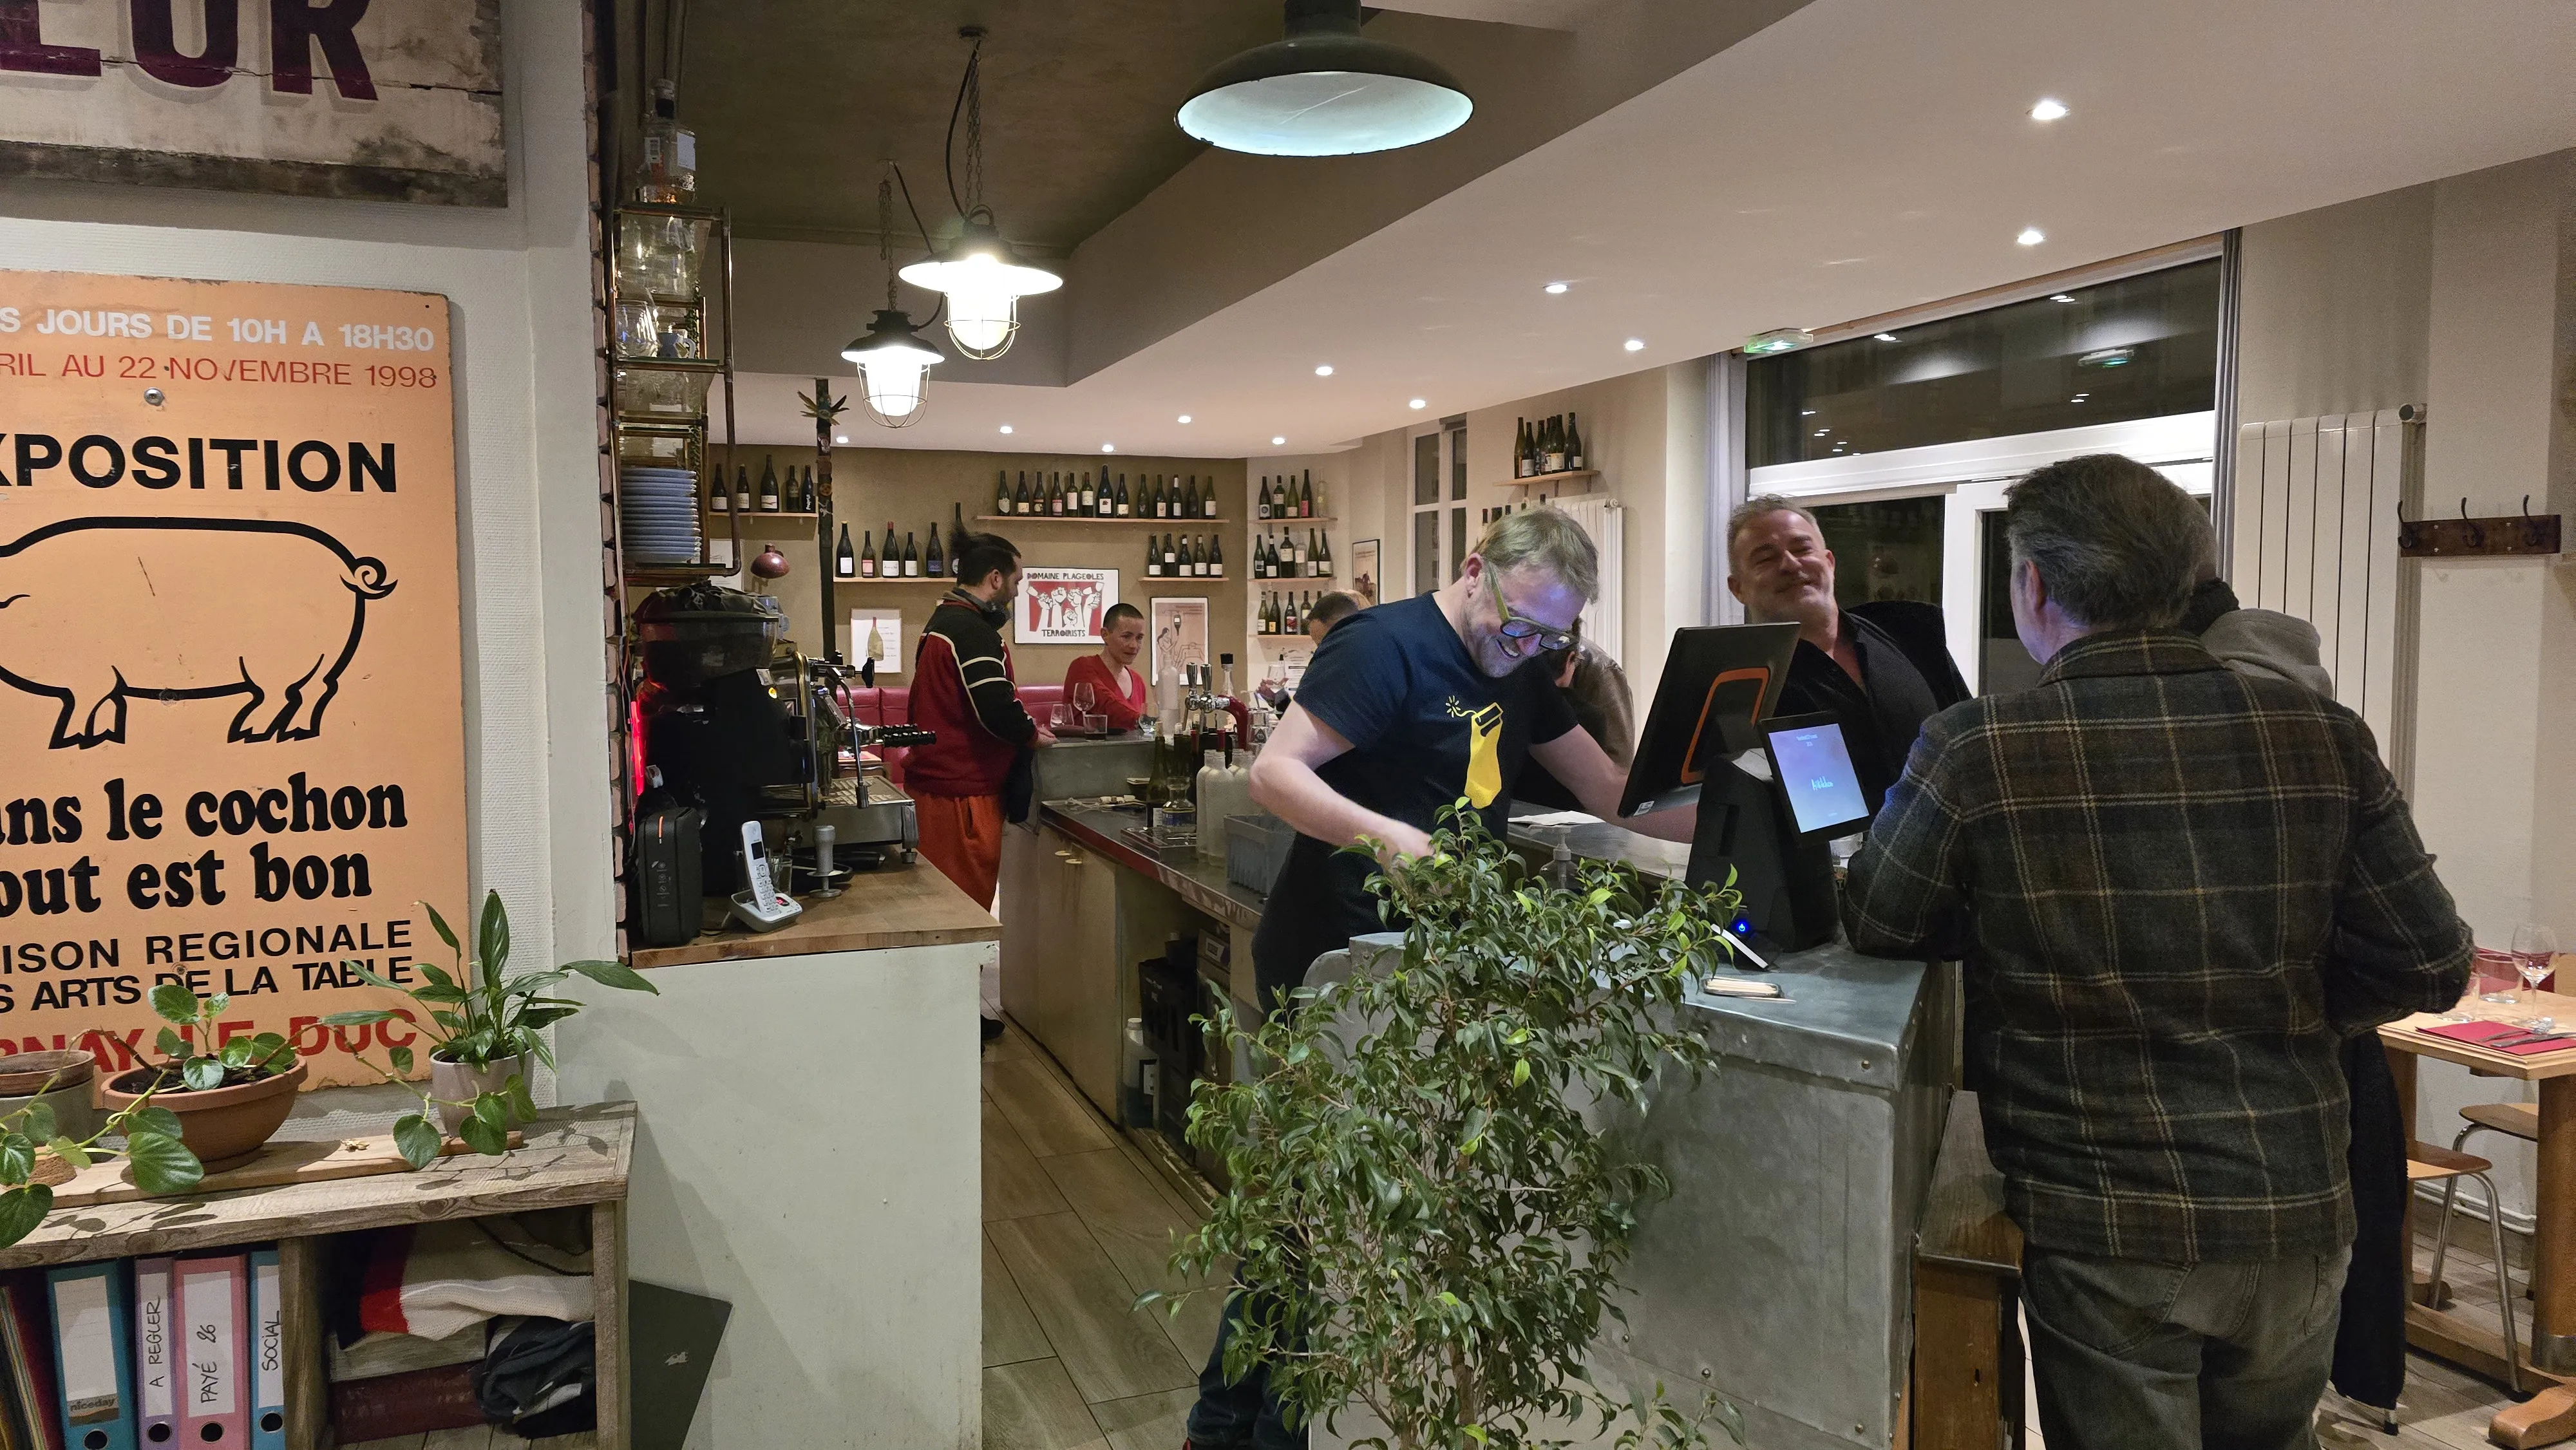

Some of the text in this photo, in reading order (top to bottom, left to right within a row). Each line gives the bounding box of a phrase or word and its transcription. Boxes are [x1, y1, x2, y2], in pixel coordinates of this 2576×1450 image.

[37, 308, 153, 338] JOURS
[166, 314, 213, 341] DE
[227, 317, 287, 344] 10H
[301, 321, 325, 346] A
[338, 323, 435, 352] 18H30
[62, 354, 105, 377] AU
[118, 356, 156, 379] 22
[169, 357, 352, 386] NOVEMBRE
[364, 364, 437, 388] 1998
[0, 433, 397, 493] POSITION
[0, 771, 408, 845] ns le cochon
[127, 849, 226, 910] est
[249, 841, 372, 903] bon
[146, 919, 412, 965] REGIONALE
[30, 974, 142, 1012] ARTS
[225, 966, 279, 997] LA
[146, 1295, 165, 1388] A REGLER
[70, 1397, 117, 1413] niceday
[191, 1361, 219, 1404] PAYÉ
